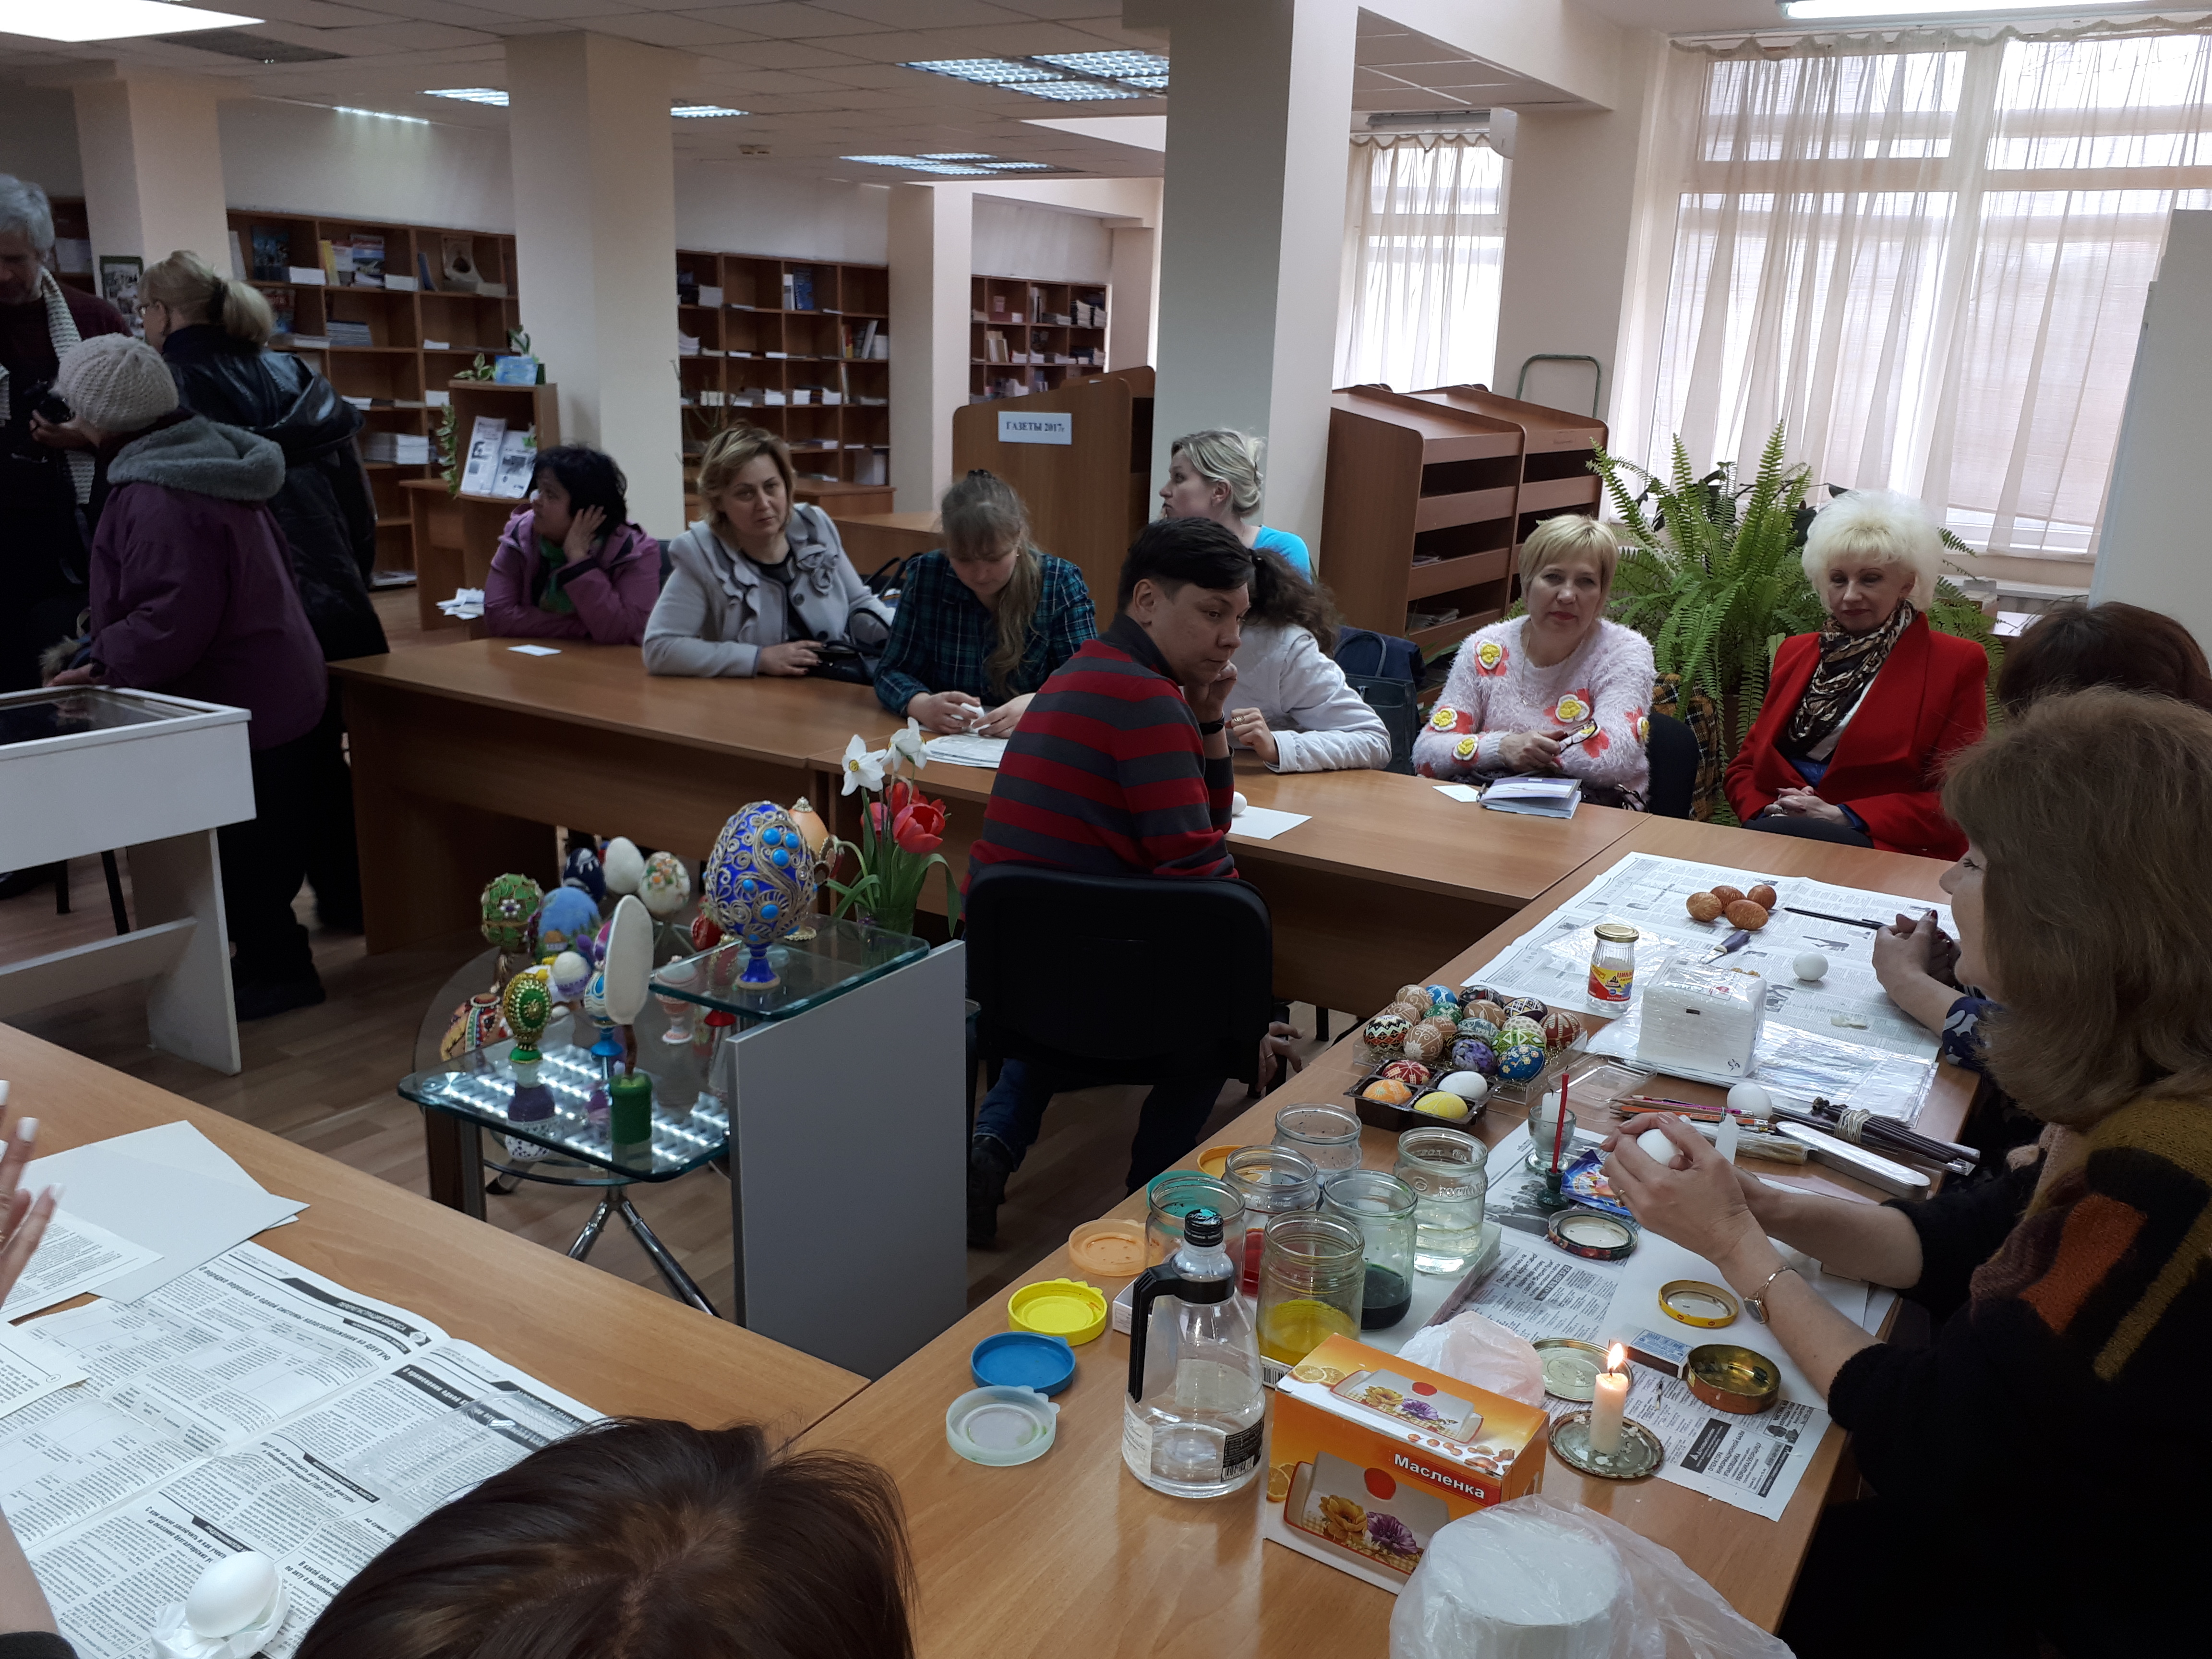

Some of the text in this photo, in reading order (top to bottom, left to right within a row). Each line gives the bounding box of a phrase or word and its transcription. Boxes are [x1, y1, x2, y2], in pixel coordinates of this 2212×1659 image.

[1007, 421, 1042, 431] ГАЗЕТЫ
[204, 1270, 229, 1283] порядке
[227, 1282, 255, 1297] перехода
[259, 1298, 279, 1308] одной
[277, 1307, 304, 1320] системы
[303, 1318, 358, 1341] налогообложения
[364, 1343, 391, 1361] другую
[407, 1370, 444, 1392] применении
[441, 1389, 462, 1402] одной
[1707, 1452, 1723, 1471] ОПЕРАТОРА
[1716, 1439, 1741, 1474] ИНФОРМАЦИОННОЙ
[1734, 1430, 1746, 1440] БАЗЫ
[285, 1466, 312, 1483] накладной
[286, 1456, 309, 1473] совпадать
[307, 1472, 322, 1481] даты
[320, 1480, 356, 1503] счета-фактуры
[1394, 1453, 1485, 1499] Масленка
[153, 1522, 176, 1537] оказание
[173, 1534, 209, 1559] бухгалтерских
[173, 1523, 199, 1540] заключить
[201, 1541, 213, 1550] как
[371, 1522, 388, 1533] сумму
[291, 1570, 305, 1580] акту
[302, 1564, 321, 1576] какой
[317, 1574, 333, 1584] срок
